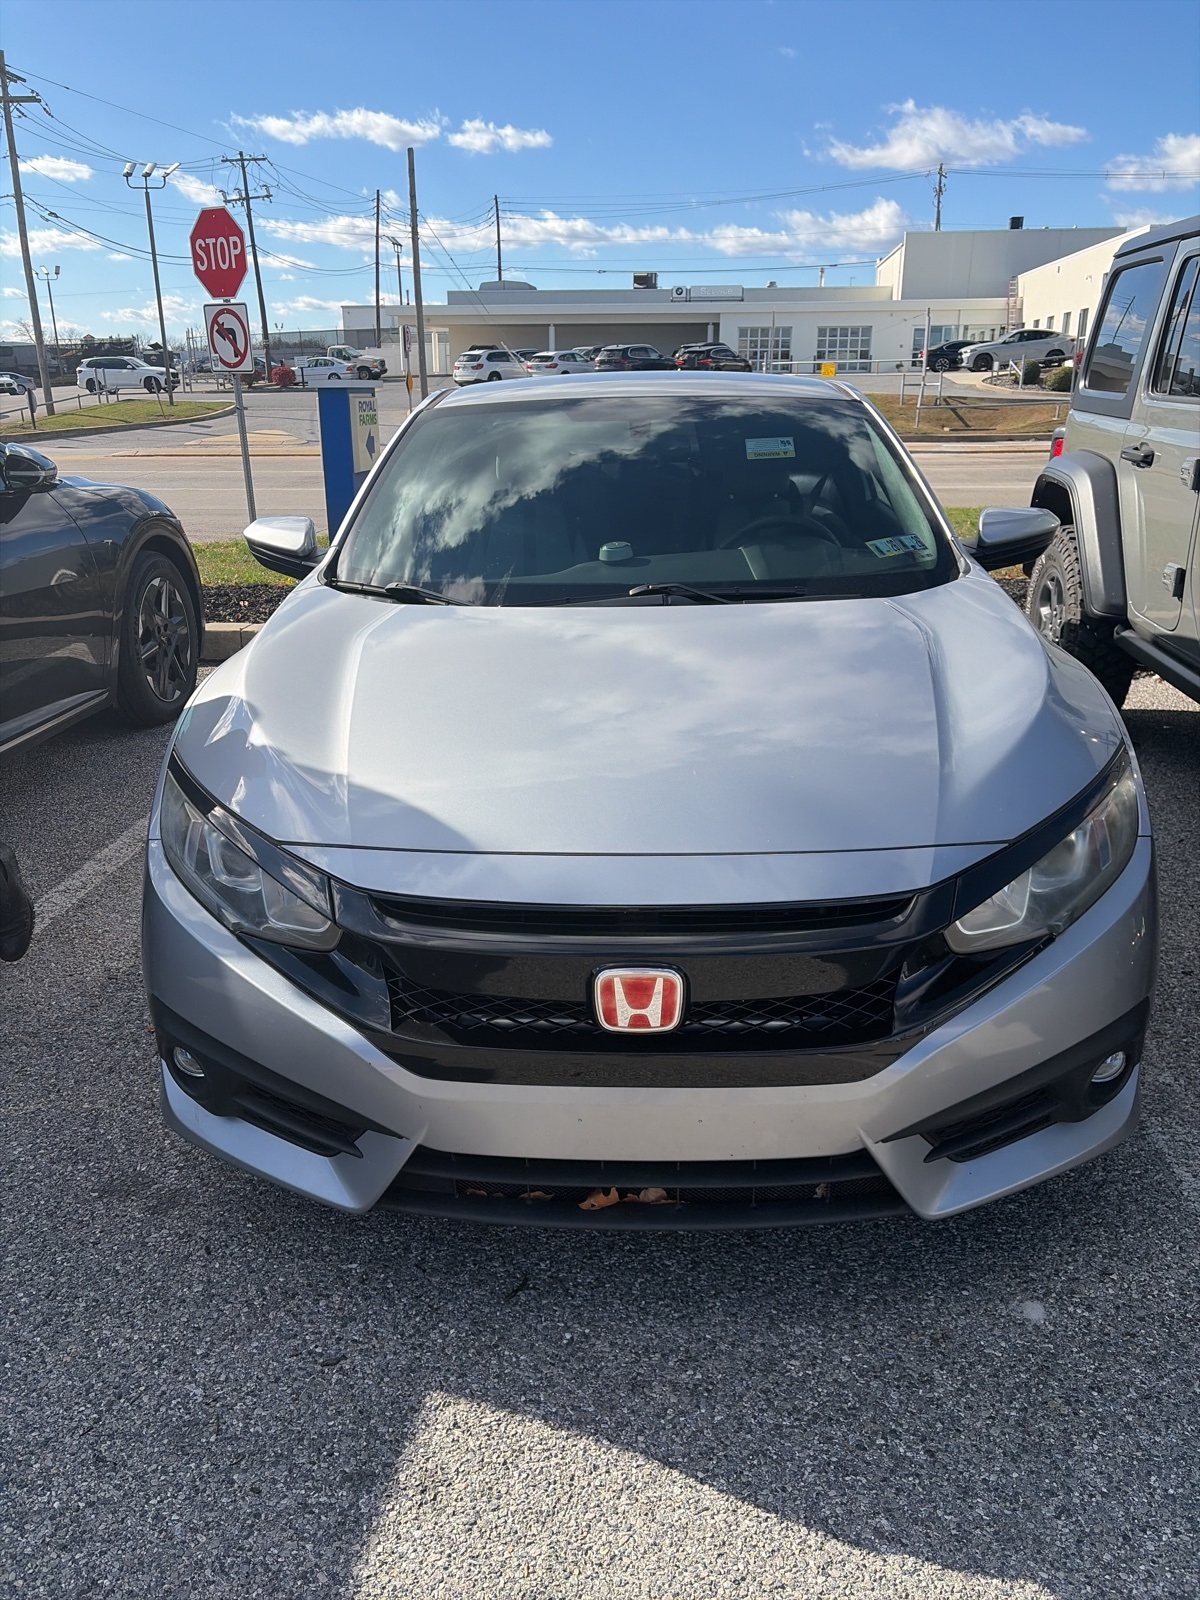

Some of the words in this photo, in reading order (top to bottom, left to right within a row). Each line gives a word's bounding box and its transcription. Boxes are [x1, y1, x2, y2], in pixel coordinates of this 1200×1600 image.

[195, 236, 242, 271] STOP
[700, 287, 733, 295] Service
[358, 401, 377, 413] ROYAL
[359, 414, 378, 426] FARMS
